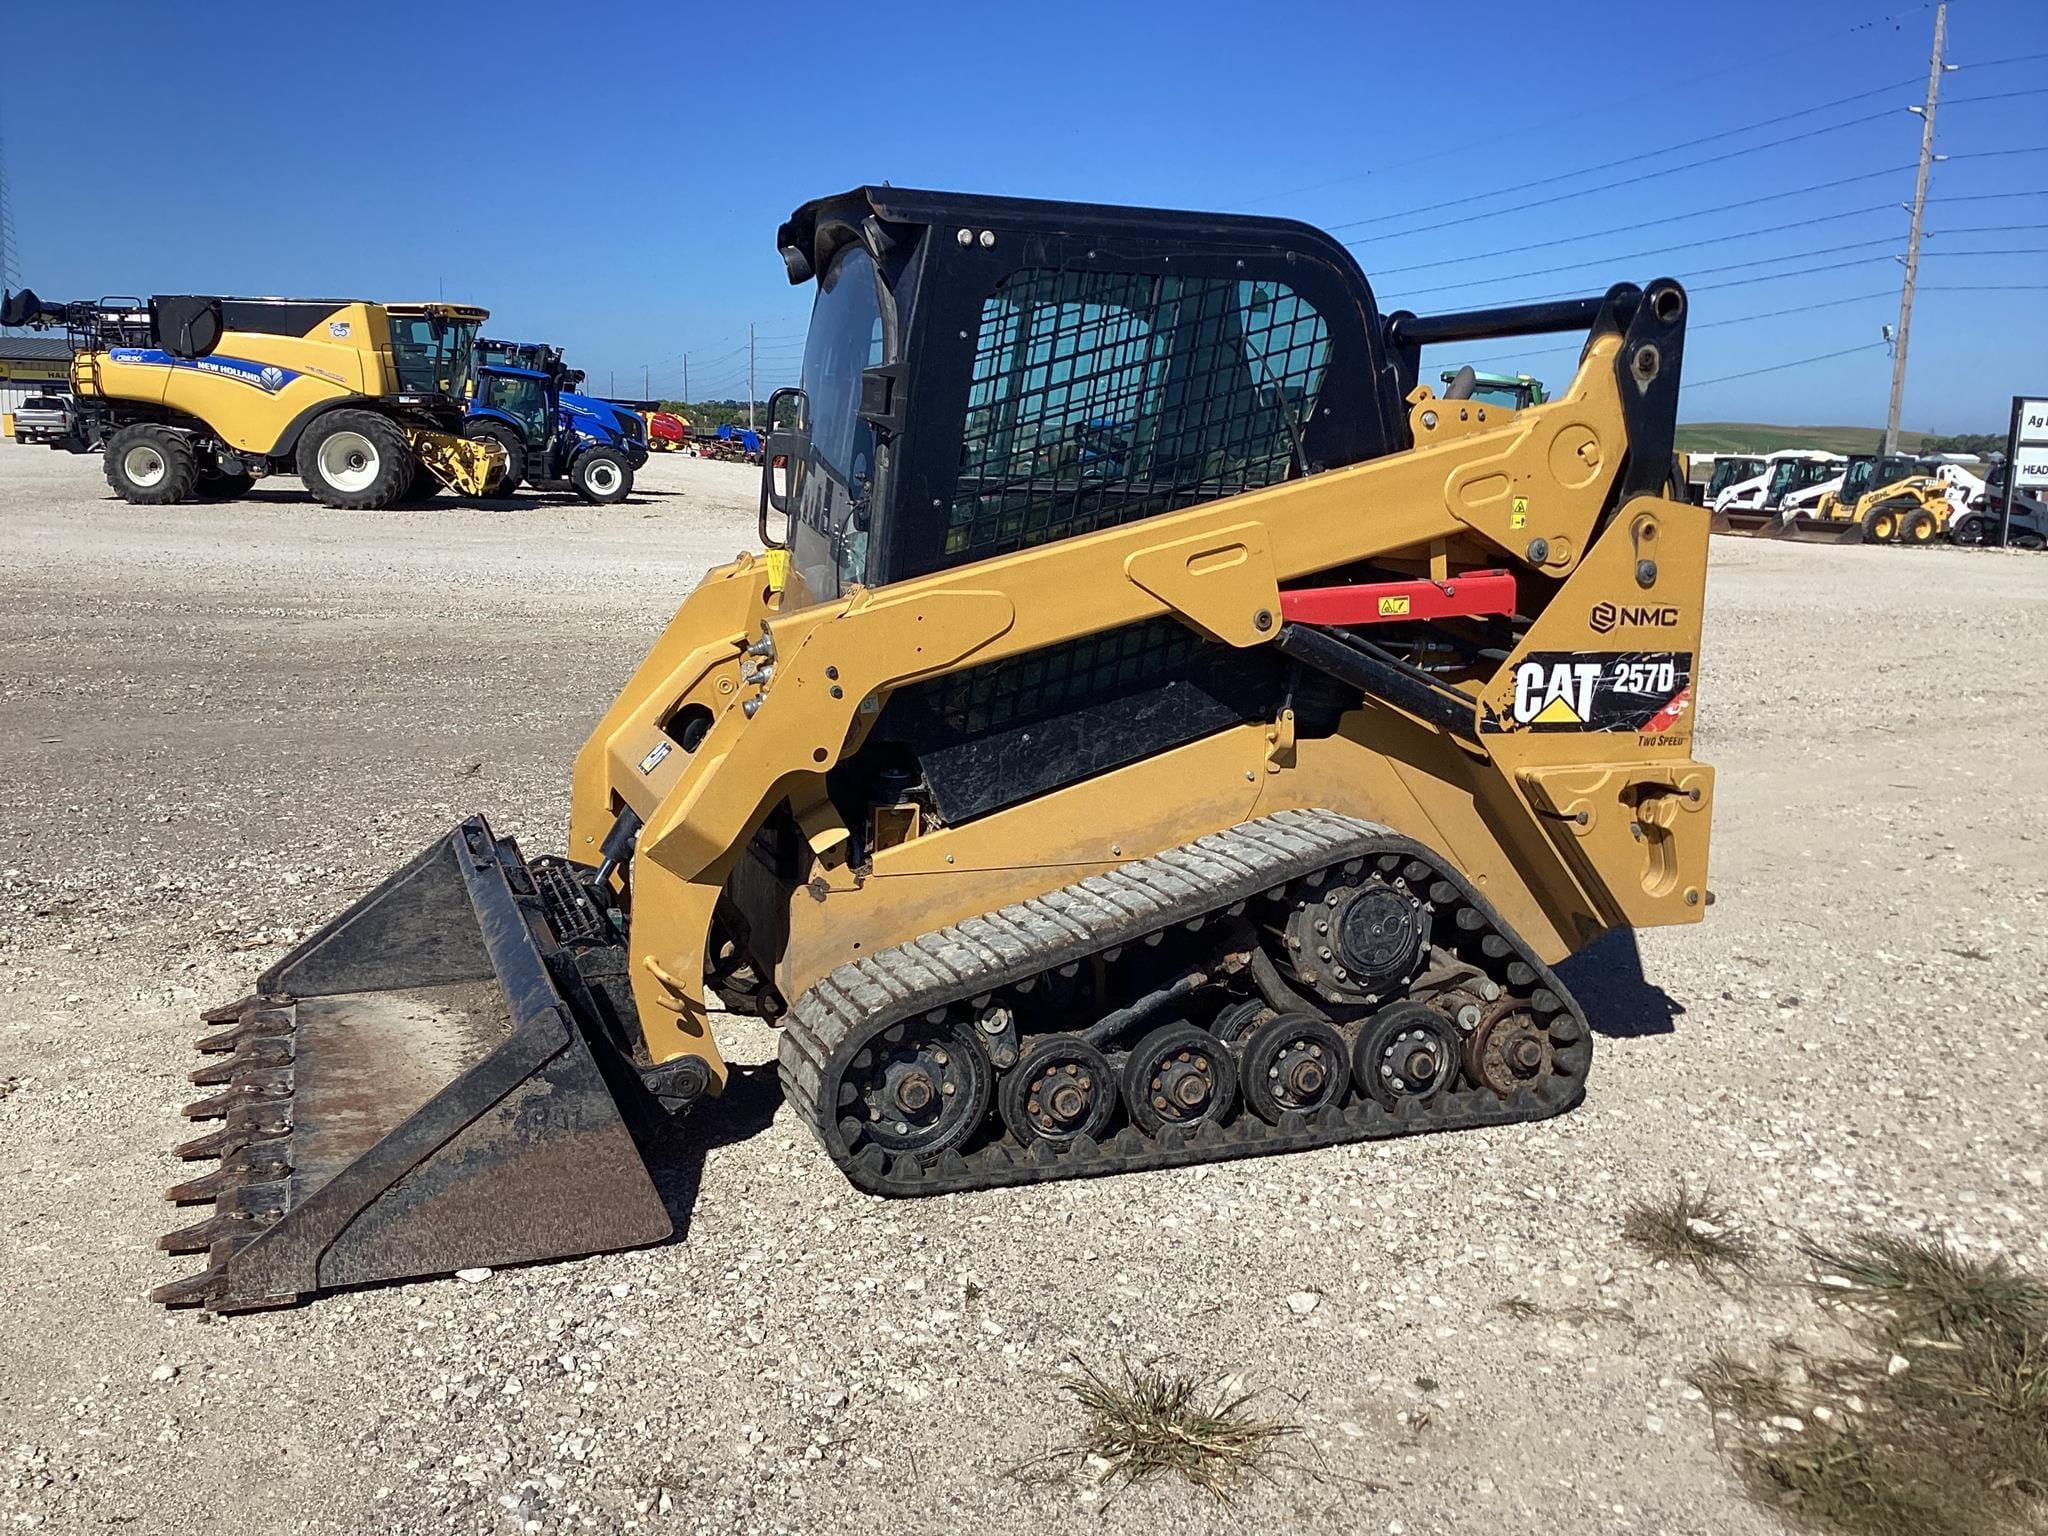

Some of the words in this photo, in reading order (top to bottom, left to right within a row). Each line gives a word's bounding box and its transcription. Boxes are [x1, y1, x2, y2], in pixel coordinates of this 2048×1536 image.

[197, 361, 219, 370] NEW
[220, 365, 261, 383] HOLLAND
[2028, 416, 2044, 428] Ag
[1620, 608, 1678, 626] NMC
[1514, 662, 1601, 723] CAT
[1613, 664, 1675, 693] 257D
